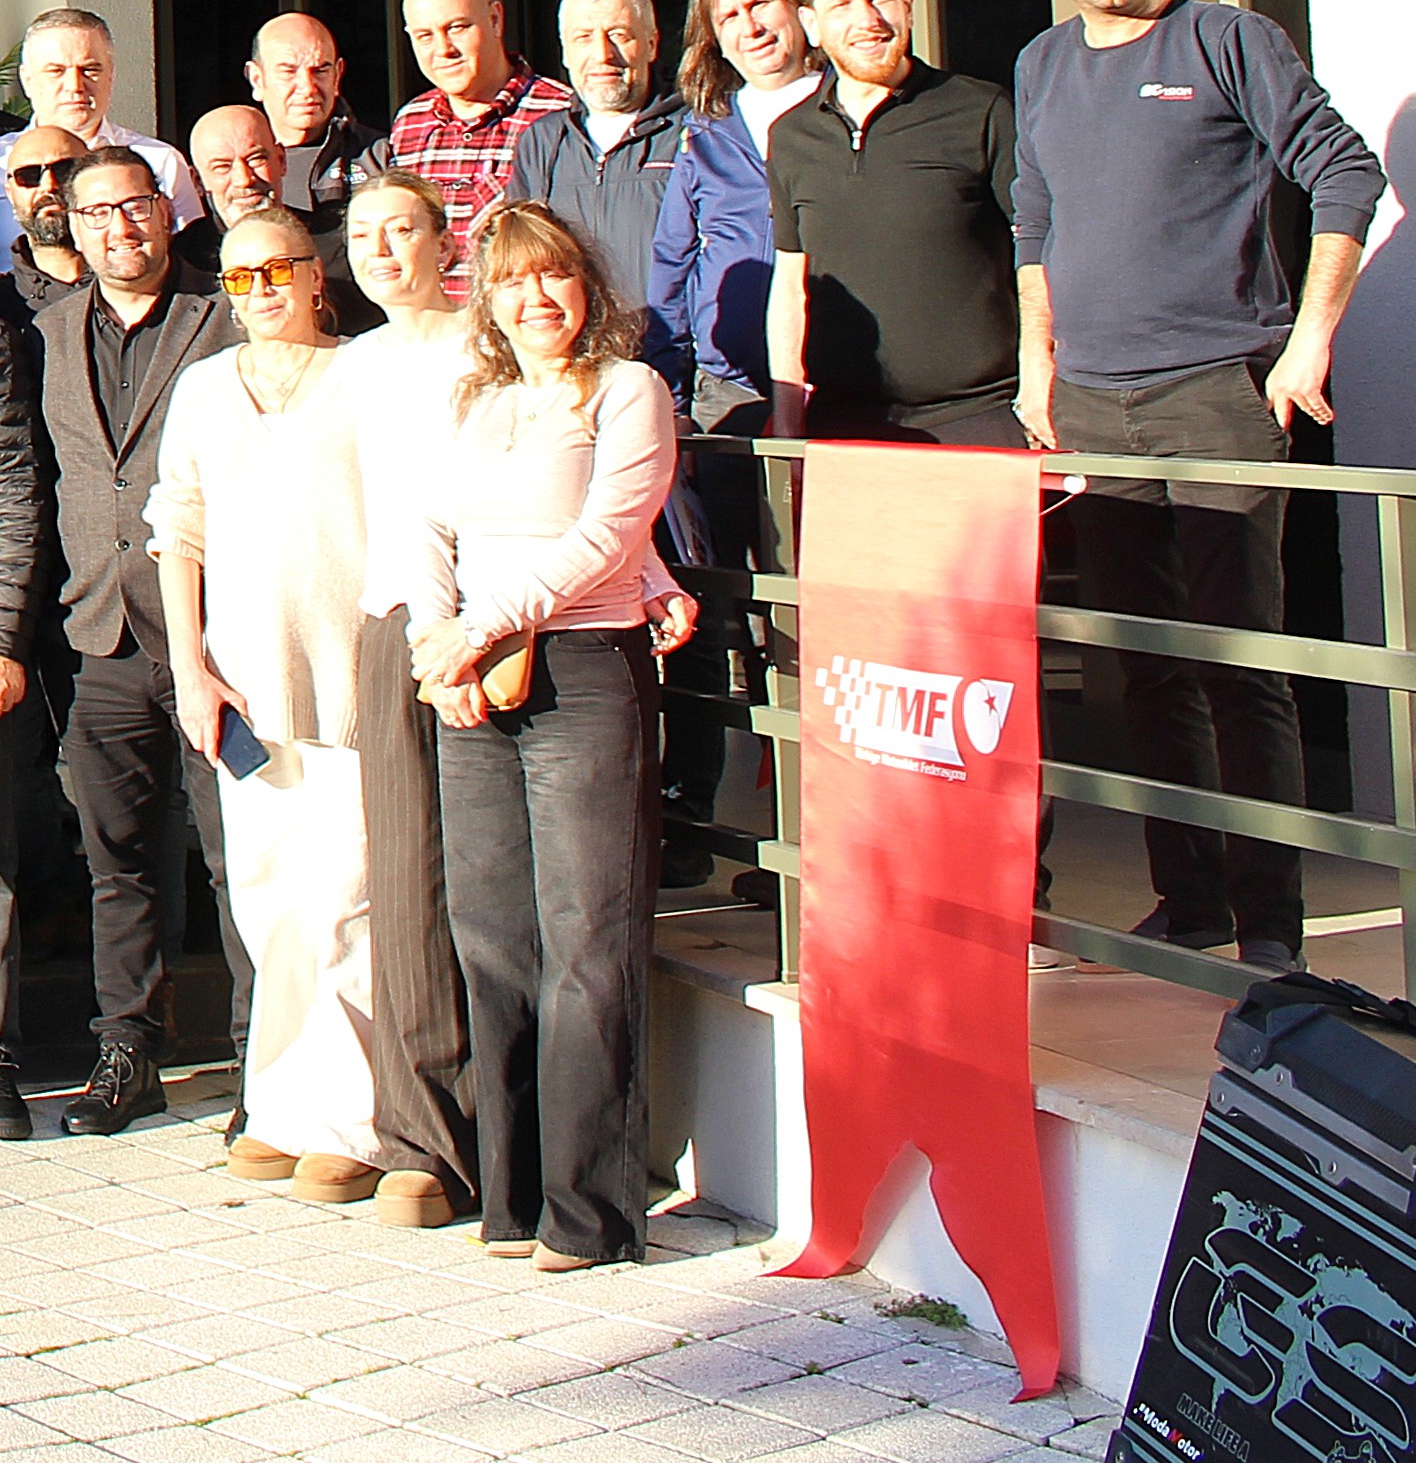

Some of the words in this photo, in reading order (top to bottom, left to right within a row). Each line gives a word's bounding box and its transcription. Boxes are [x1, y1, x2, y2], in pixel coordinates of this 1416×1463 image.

[874, 682, 949, 738] TMF
[1176, 1392, 1216, 1435] MAKE
[1211, 1416, 1242, 1455] LIFE
